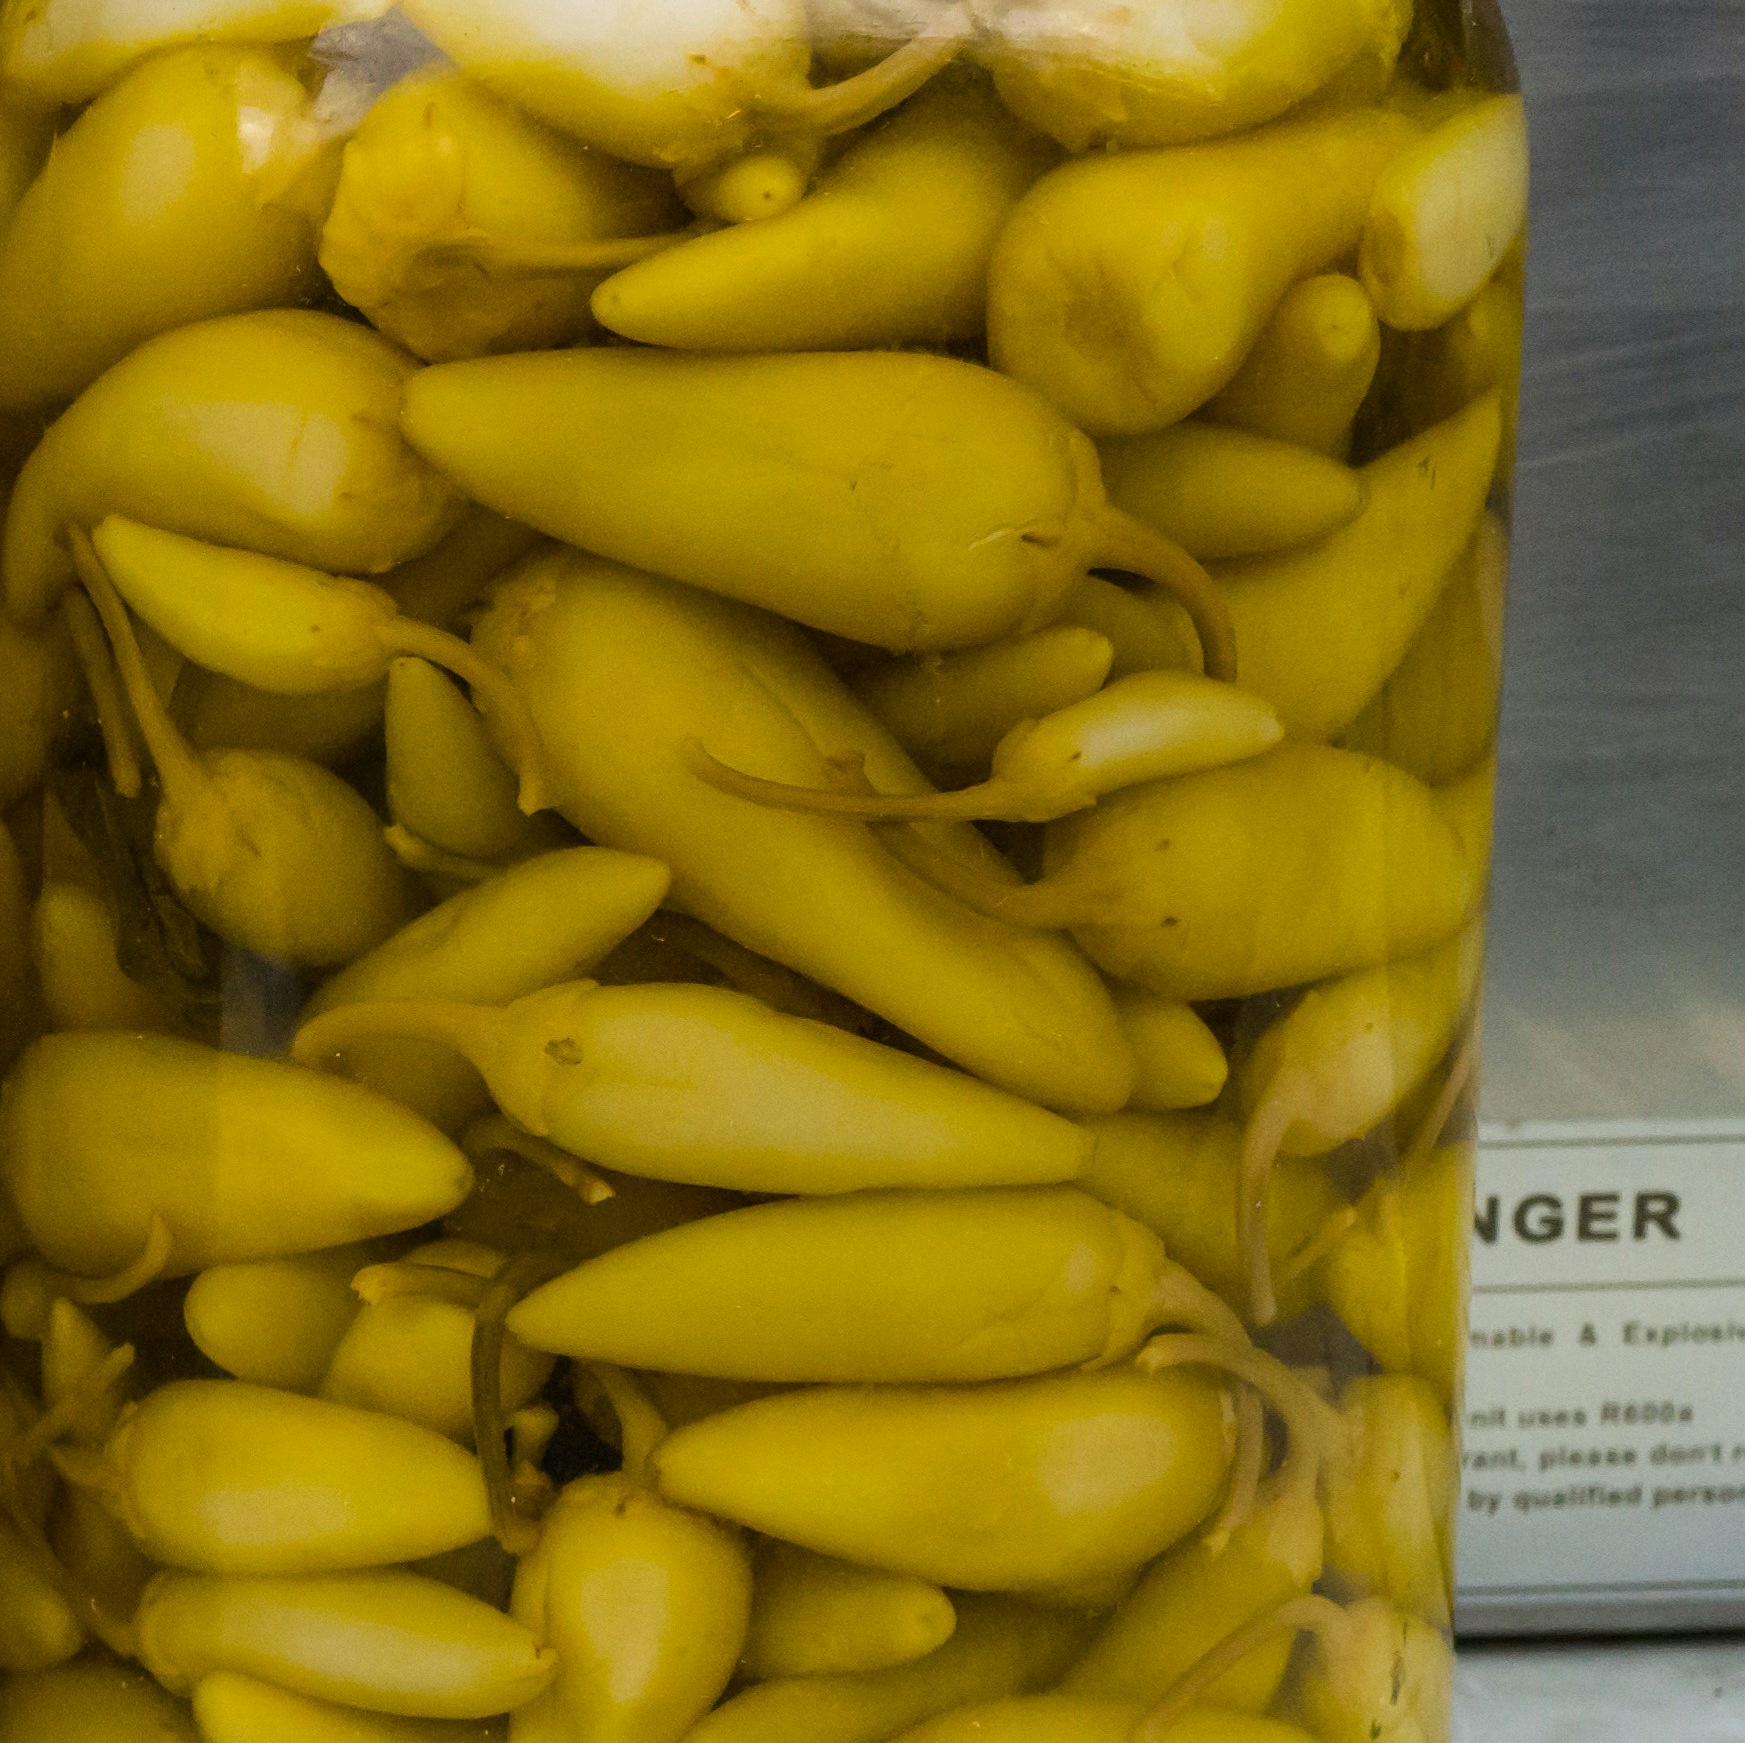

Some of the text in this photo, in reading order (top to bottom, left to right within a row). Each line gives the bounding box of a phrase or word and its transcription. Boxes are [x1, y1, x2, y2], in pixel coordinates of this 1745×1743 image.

[1473, 1191, 1681, 1245] NGER
[1518, 1409, 1588, 1429] uses
[1539, 1444, 1638, 1473] please
[1467, 1488, 1502, 1517] by
